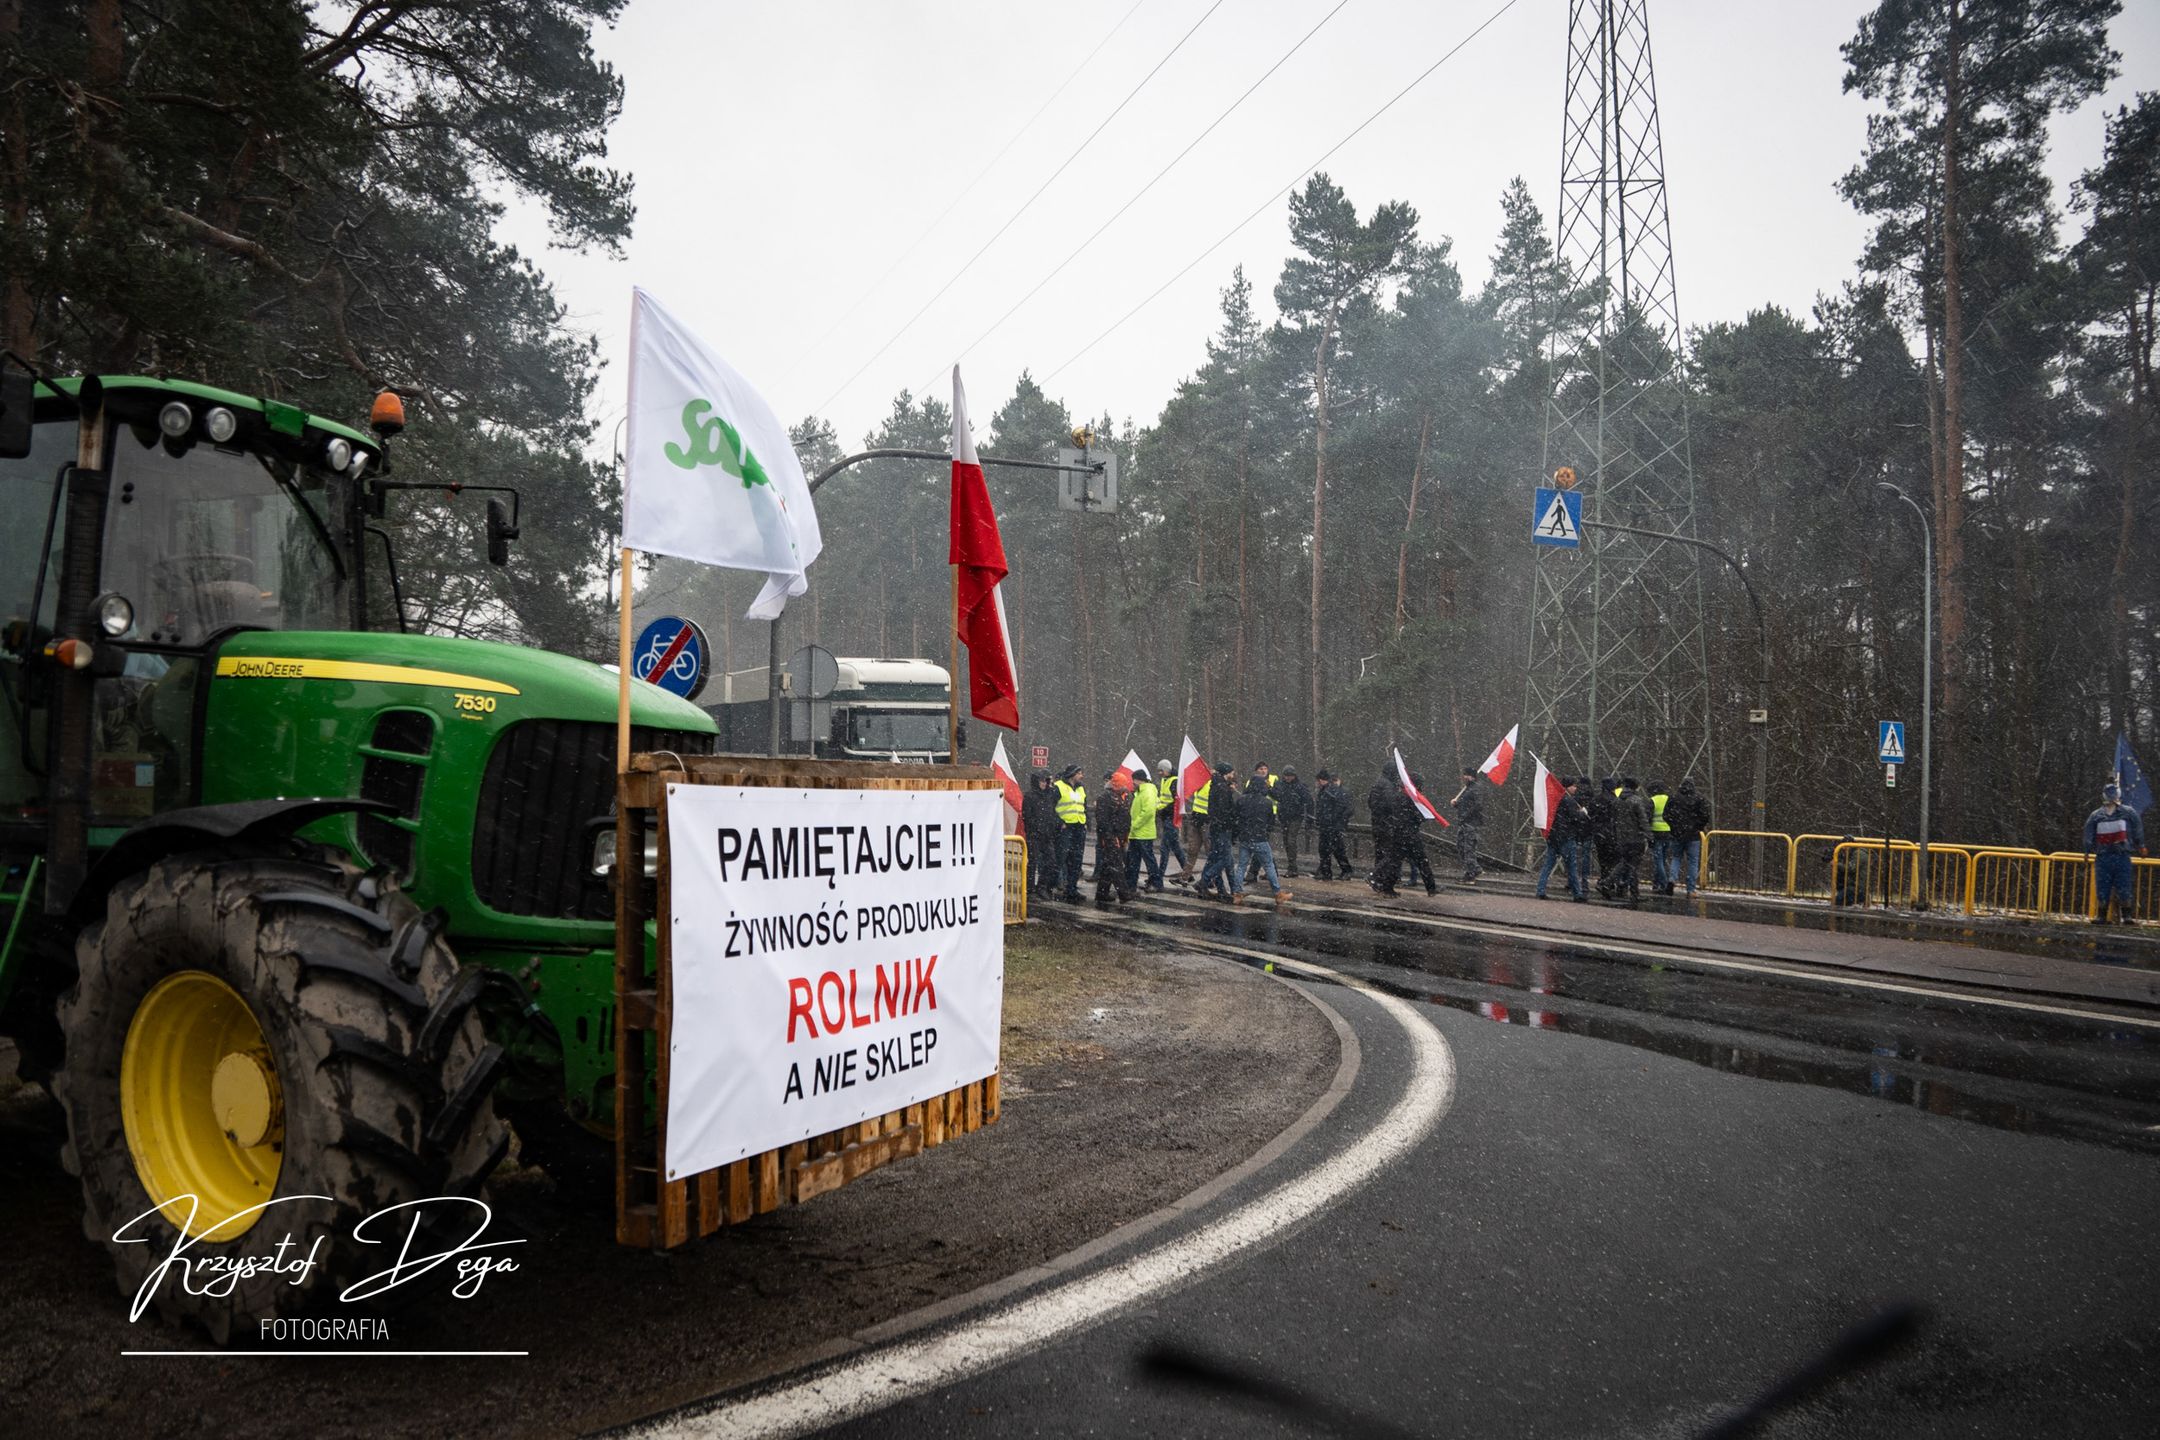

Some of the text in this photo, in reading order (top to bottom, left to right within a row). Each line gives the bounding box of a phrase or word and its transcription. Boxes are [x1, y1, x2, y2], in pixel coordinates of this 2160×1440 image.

[232, 661, 304, 676] JOHN DEERE
[453, 693, 497, 713] 7530
[717, 822, 976, 890] PAMIĘTAJCIE !!!
[724, 894, 980, 958] ŻYWNOŚĆ PRODUKUJE
[787, 954, 938, 1043] ROLNIK
[783, 1027, 937, 1105] A NIE SKLEP
